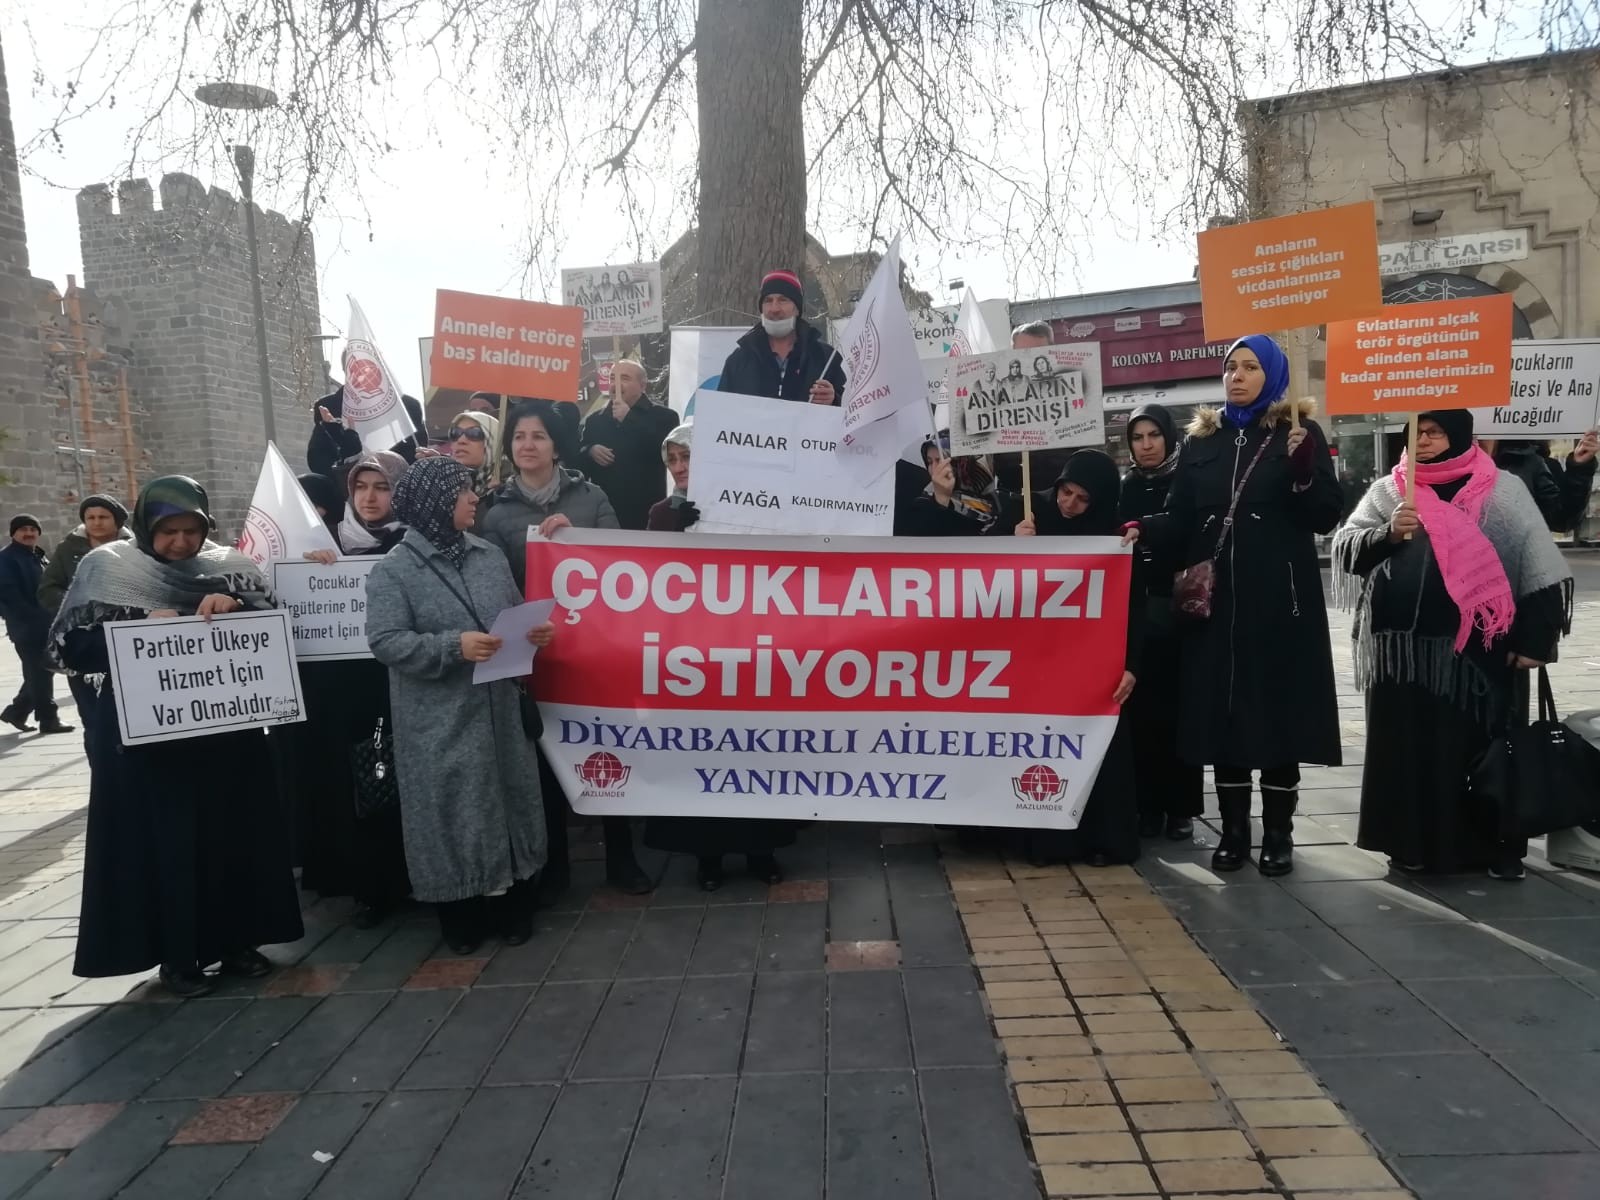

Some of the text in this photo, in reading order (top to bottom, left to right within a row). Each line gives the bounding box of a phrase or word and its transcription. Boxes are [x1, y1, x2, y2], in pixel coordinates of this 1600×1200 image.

[1255, 237, 1317, 257] Anaların
[1231, 250, 1345, 279] sessiz çığlıkları
[1237, 269, 1342, 295] vicdanlarınıza
[1252, 288, 1329, 310] sesleniyor
[441, 316, 516, 341] Anneler
[519, 326, 576, 349] teröre
[1356, 312, 1480, 333] Evlatlarını alçak
[1355, 329, 1480, 350] terör örgütünün
[443, 341, 570, 374] baş kaldırıyor
[1111, 352, 1163, 368] KOLONYA
[1365, 348, 1469, 366] elinden alana
[1511, 353, 1574, 371] cukların
[1340, 362, 1495, 385] kadar annelerimizin
[1373, 383, 1459, 401] yanındayız
[1510, 378, 1593, 397] ilesi Ve Ana
[1492, 405, 1564, 427] Kucağıdır
[716, 430, 788, 451] ANALAR
[719, 489, 781, 510] AYAĞA
[309, 575, 361, 593] Çocuklar
[551, 557, 1105, 625] ÇOCUKLARIMIZI
[292, 624, 334, 640] Hizmet
[338, 621, 360, 640] İçin
[132, 627, 270, 660] Partiler Ülkeye
[158, 659, 264, 691] Hizmet İçin
[642, 632, 1011, 699] İSTİYORUZ
[152, 692, 272, 728] Var Olmalıdır
[558, 715, 1086, 760] DİYARBAKIRLI AİLELERİN
[694, 767, 948, 800] YANINDAYIZ
[1015, 802, 1063, 812] MAZLUMDER
